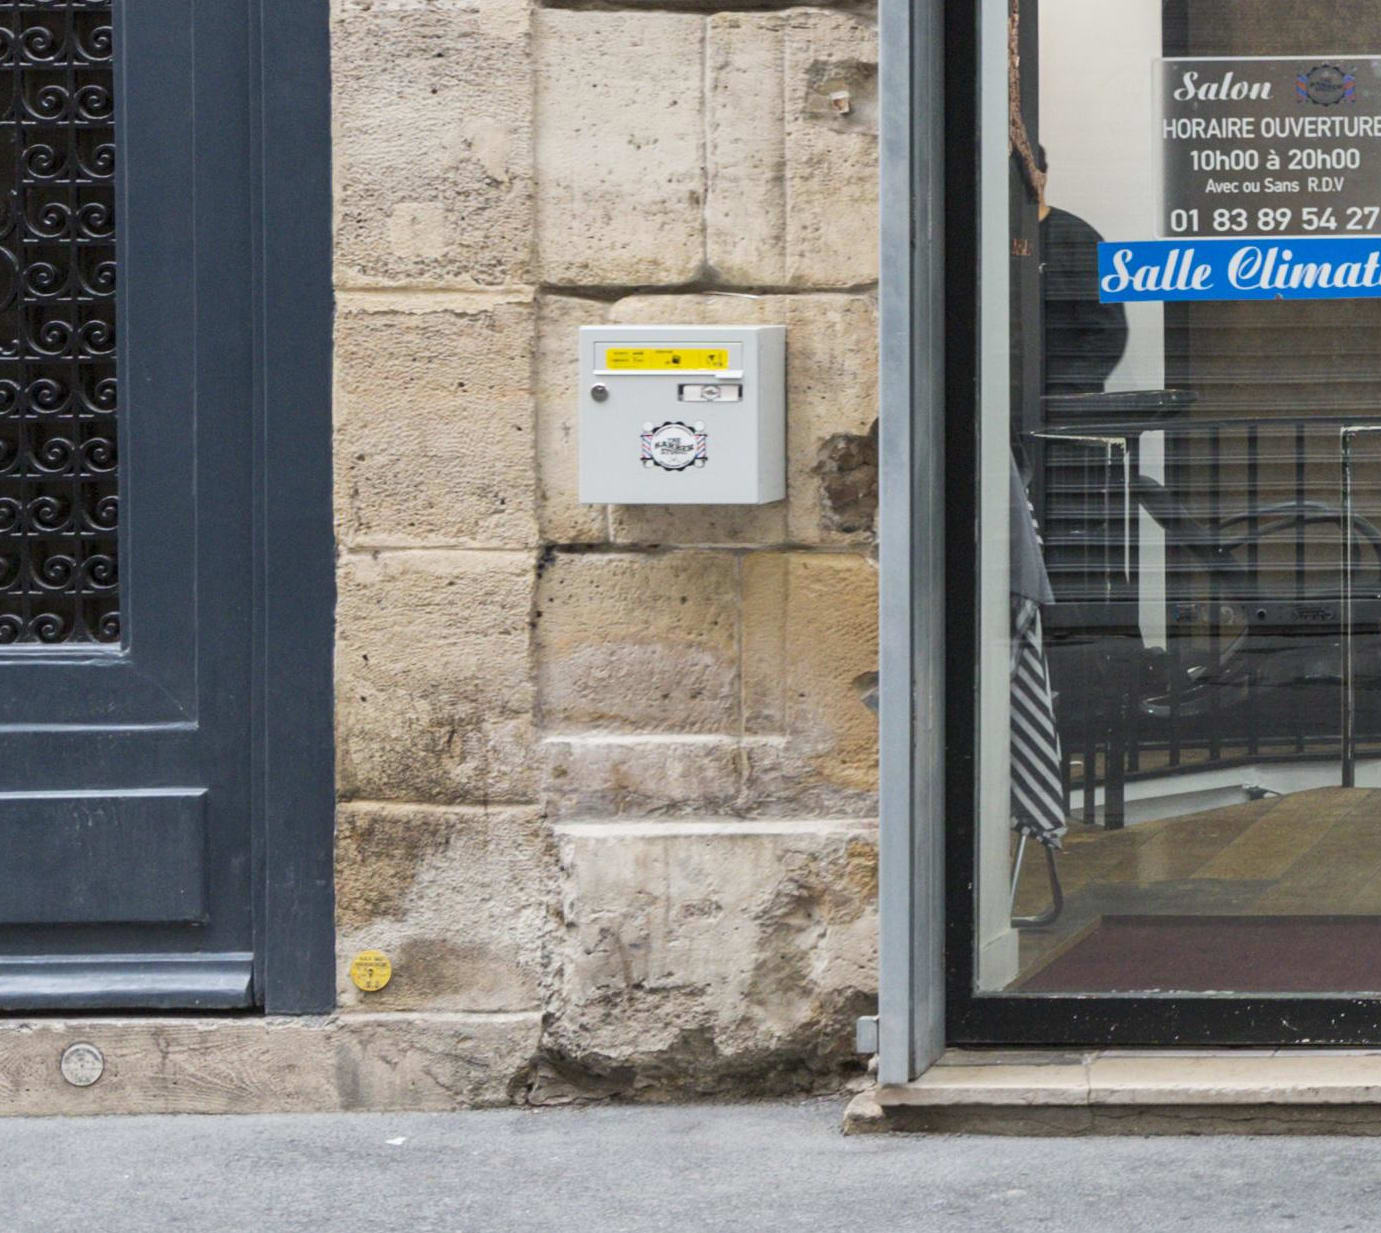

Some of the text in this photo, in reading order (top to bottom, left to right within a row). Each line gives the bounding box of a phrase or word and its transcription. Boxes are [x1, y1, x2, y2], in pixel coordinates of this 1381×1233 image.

[1173, 71, 1272, 102] Salon
[1163, 117, 1255, 139] HORAIRE
[1190, 148, 1360, 171] 10h00 à 20h00
[1205, 177, 1239, 193] Avec
[1242, 180, 1260, 193] ou
[1264, 177, 1299, 193] Sans
[1171, 207, 1380, 232] 01 83 89 54 27
[1100, 249, 1214, 294] Salle
